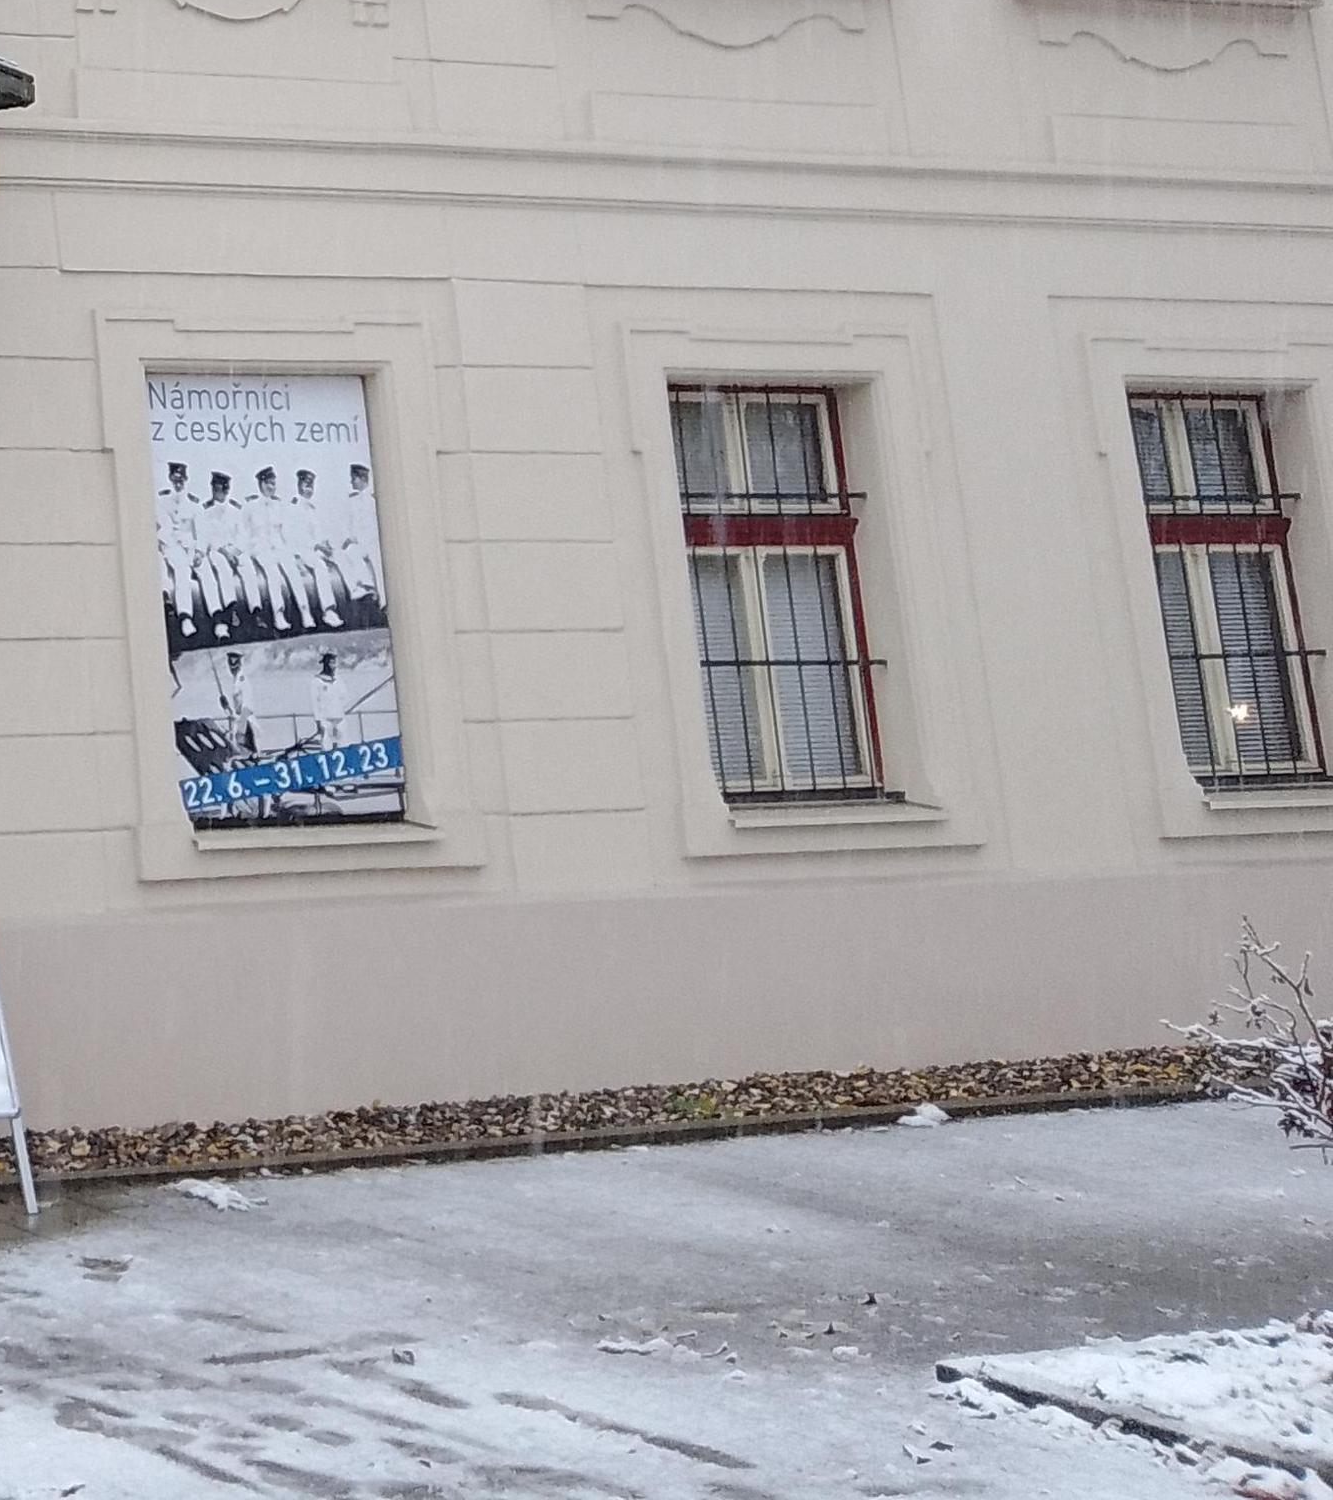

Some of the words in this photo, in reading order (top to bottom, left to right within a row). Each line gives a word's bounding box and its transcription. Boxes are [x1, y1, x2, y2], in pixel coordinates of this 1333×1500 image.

[147, 380, 291, 411] Námořníci
[151, 421, 165, 442] z
[174, 413, 285, 448] českých
[295, 415, 360, 443] zemí
[360, 743, 390, 771] 23
